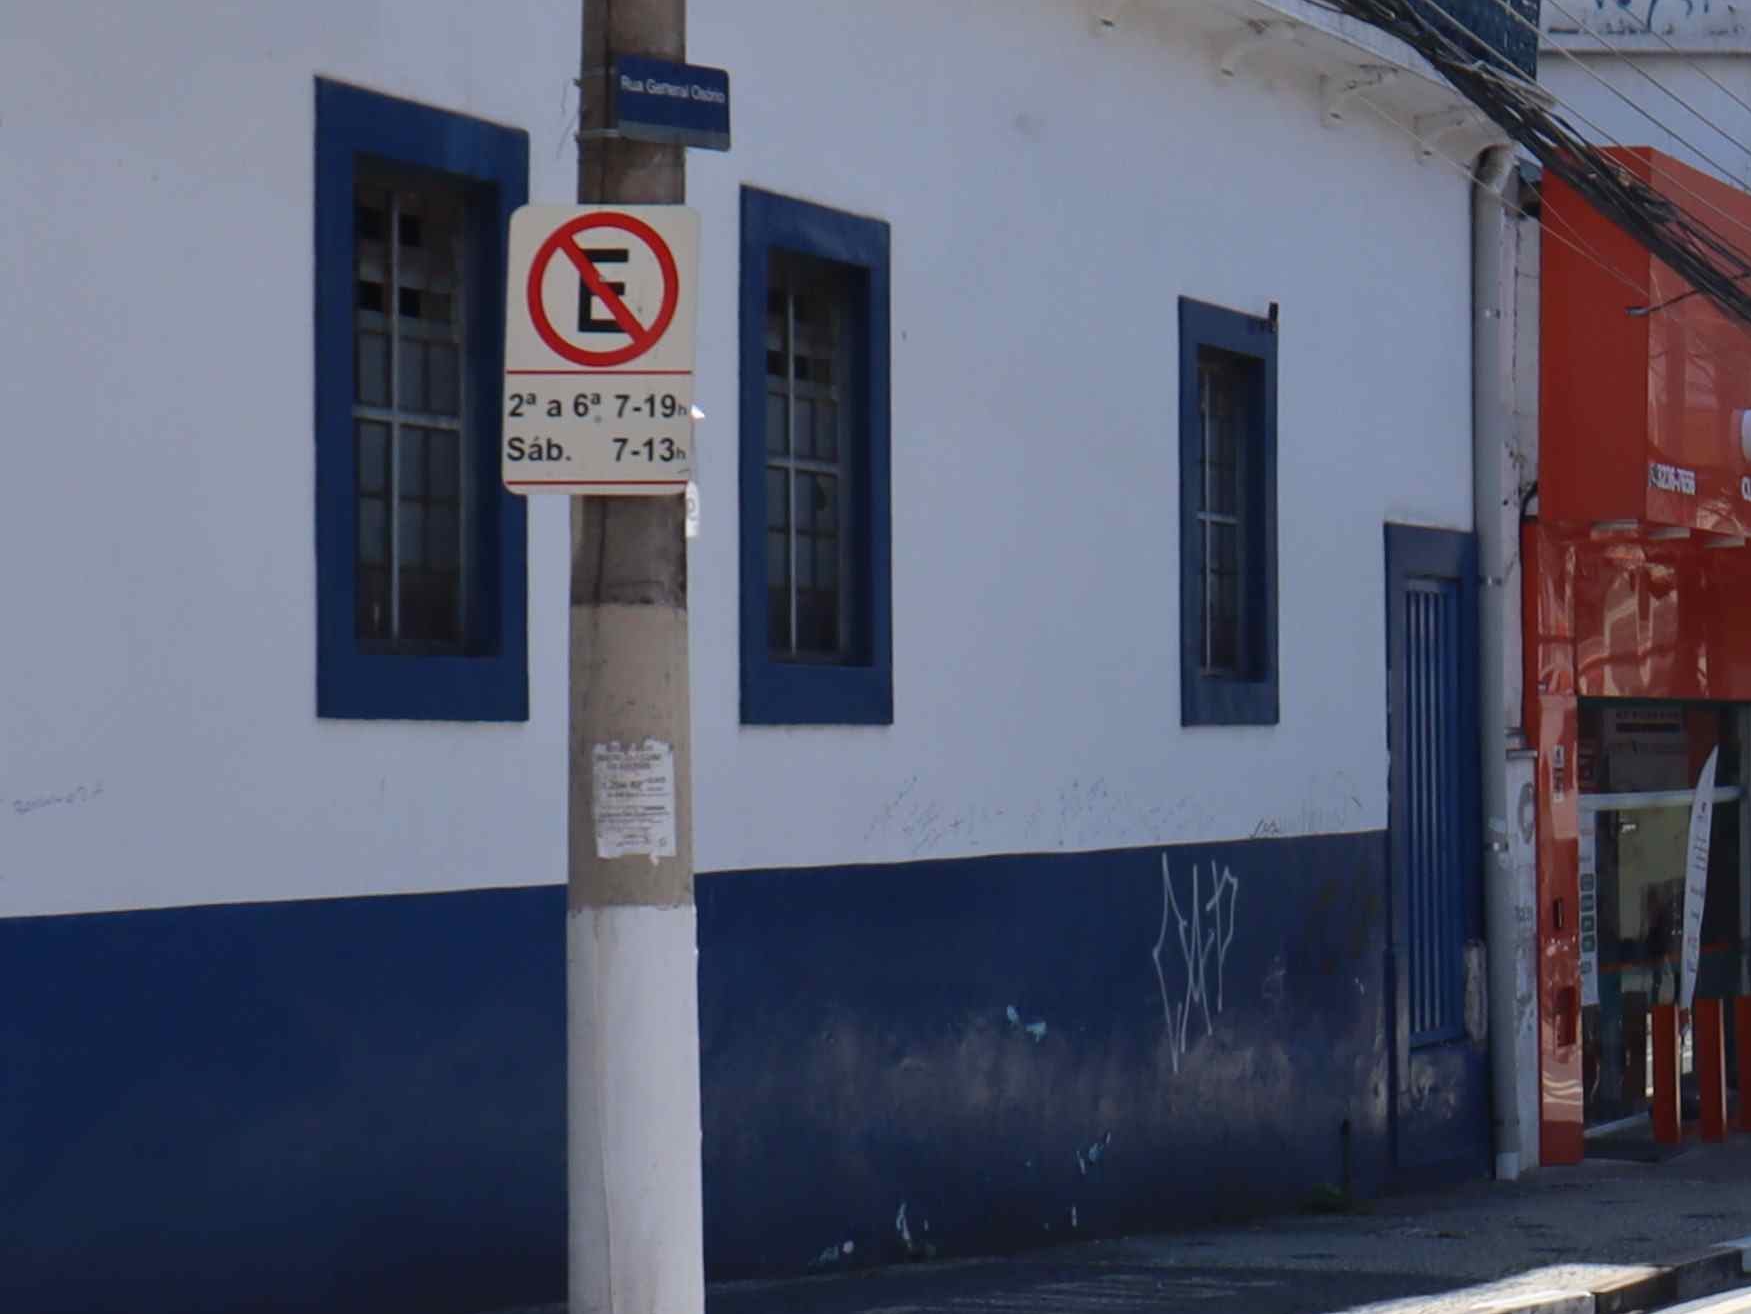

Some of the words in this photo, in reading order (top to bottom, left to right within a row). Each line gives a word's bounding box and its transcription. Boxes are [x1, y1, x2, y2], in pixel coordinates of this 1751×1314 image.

[508, 392, 537, 418] 2ª
[546, 398, 562, 418] a
[572, 392, 602, 418] 6ª
[613, 393, 689, 419] 7-19h
[505, 436, 572, 462] Sáb.
[611, 437, 687, 463] 7-13h
